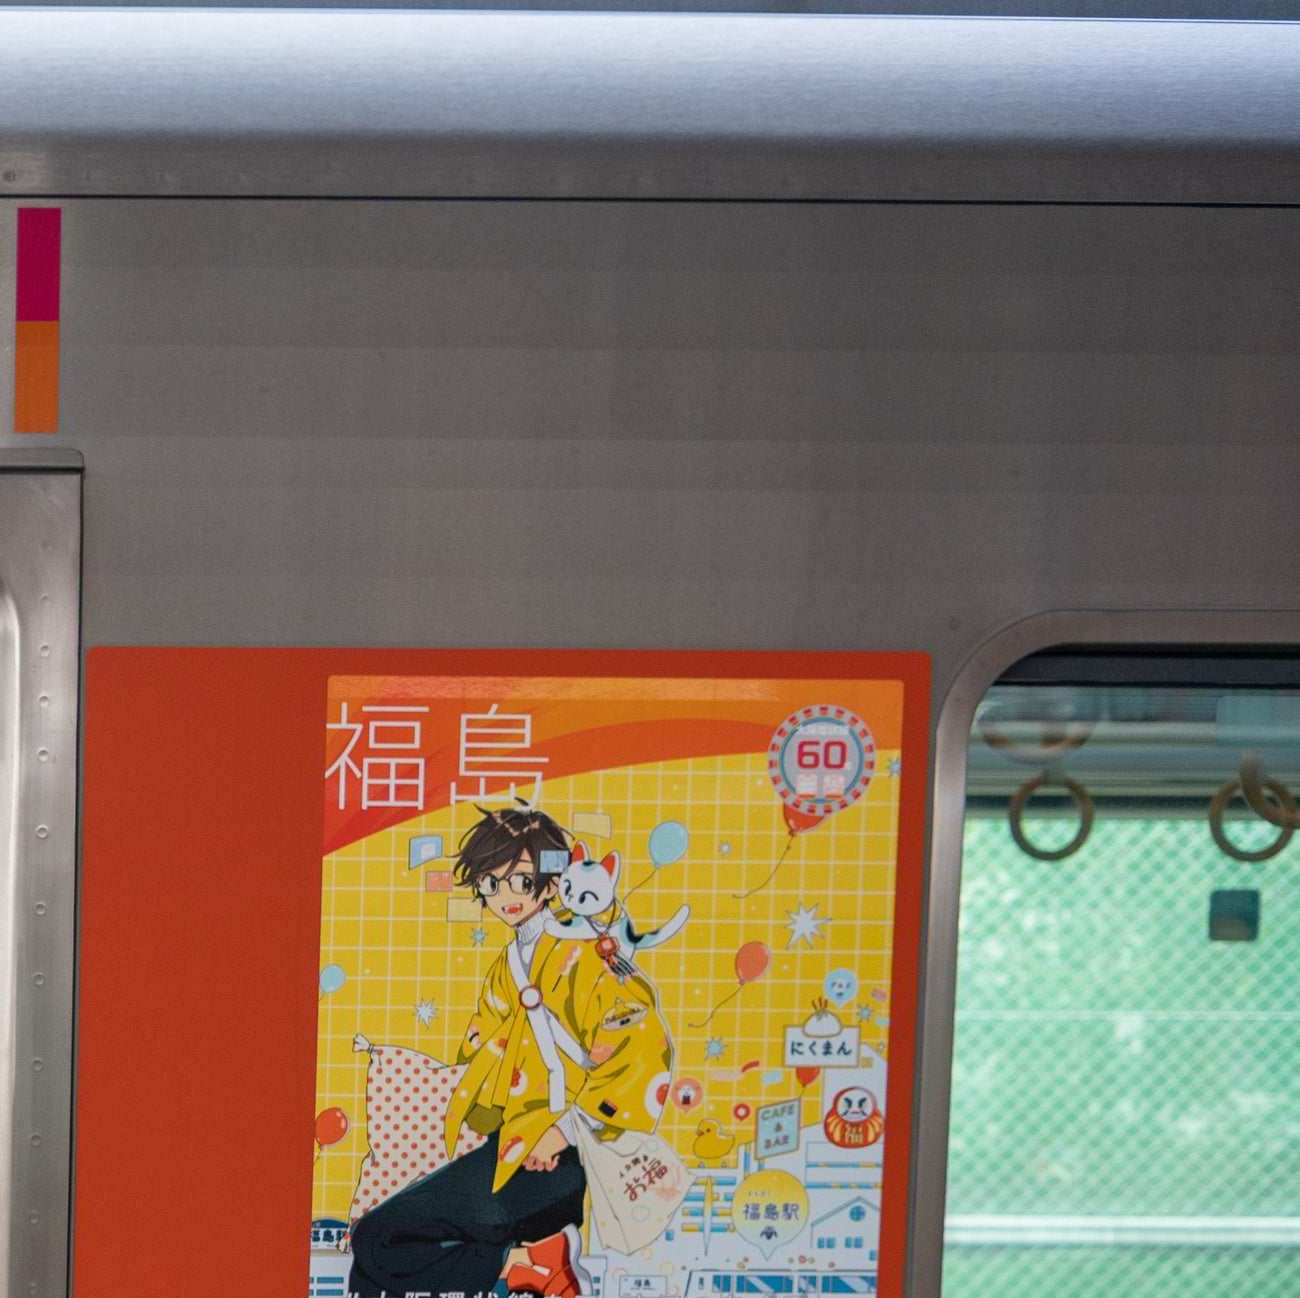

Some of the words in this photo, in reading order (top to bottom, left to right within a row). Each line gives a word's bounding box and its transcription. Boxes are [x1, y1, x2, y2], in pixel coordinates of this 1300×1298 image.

[324, 701, 550, 812] 福島
[797, 740, 847, 770] 60
[790, 1040, 852, 1056] にくまん
[761, 1104, 794, 1121] CAFE
[764, 1135, 789, 1149] BAR
[743, 1202, 800, 1221] 福島駅
